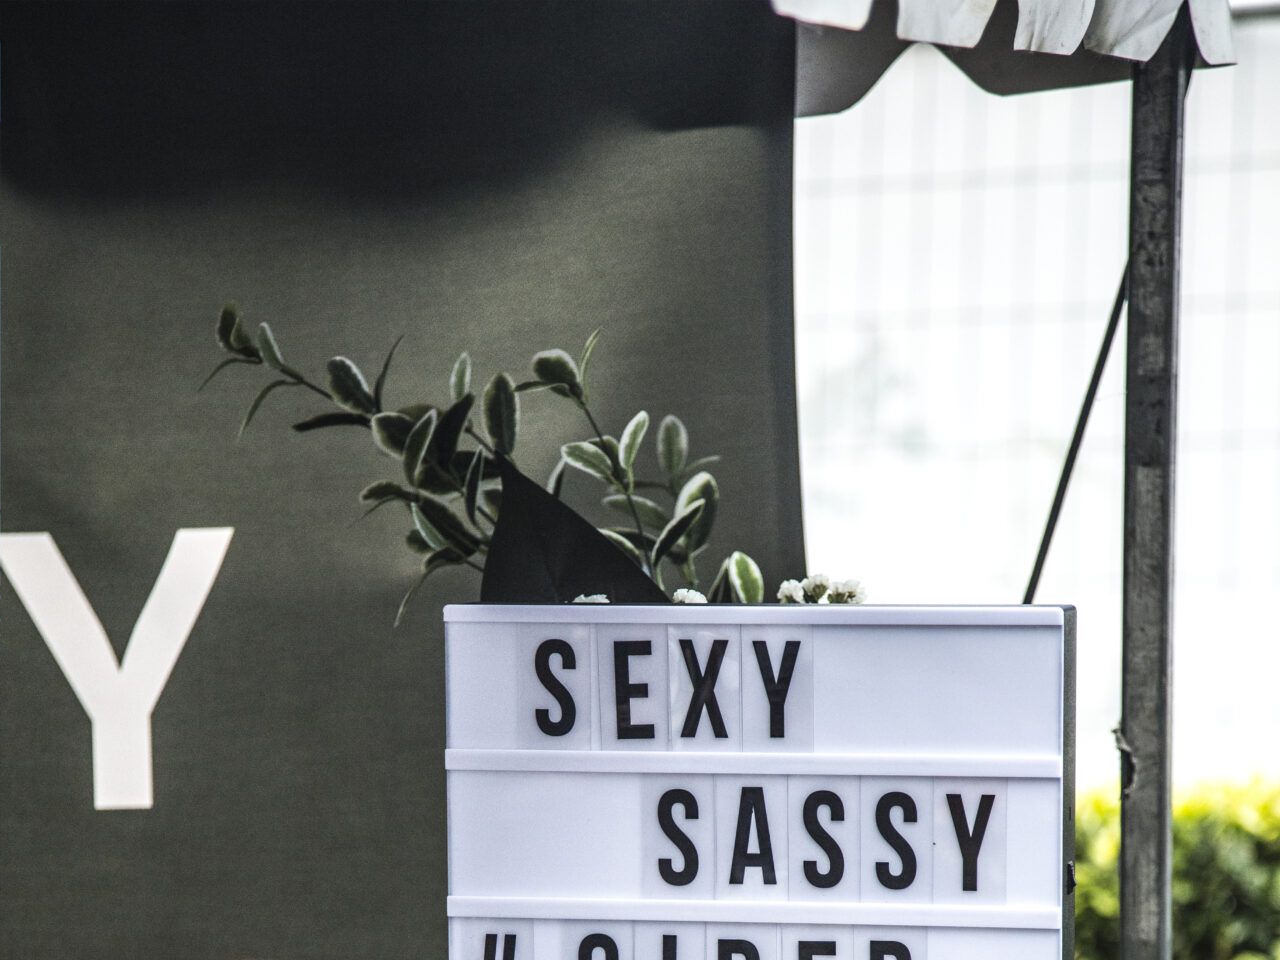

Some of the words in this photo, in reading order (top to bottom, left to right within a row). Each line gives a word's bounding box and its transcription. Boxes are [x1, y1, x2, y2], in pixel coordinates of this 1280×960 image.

[0, 526, 235, 810] Y
[534, 638, 801, 740] SEXY
[657, 786, 996, 893] SASSY
